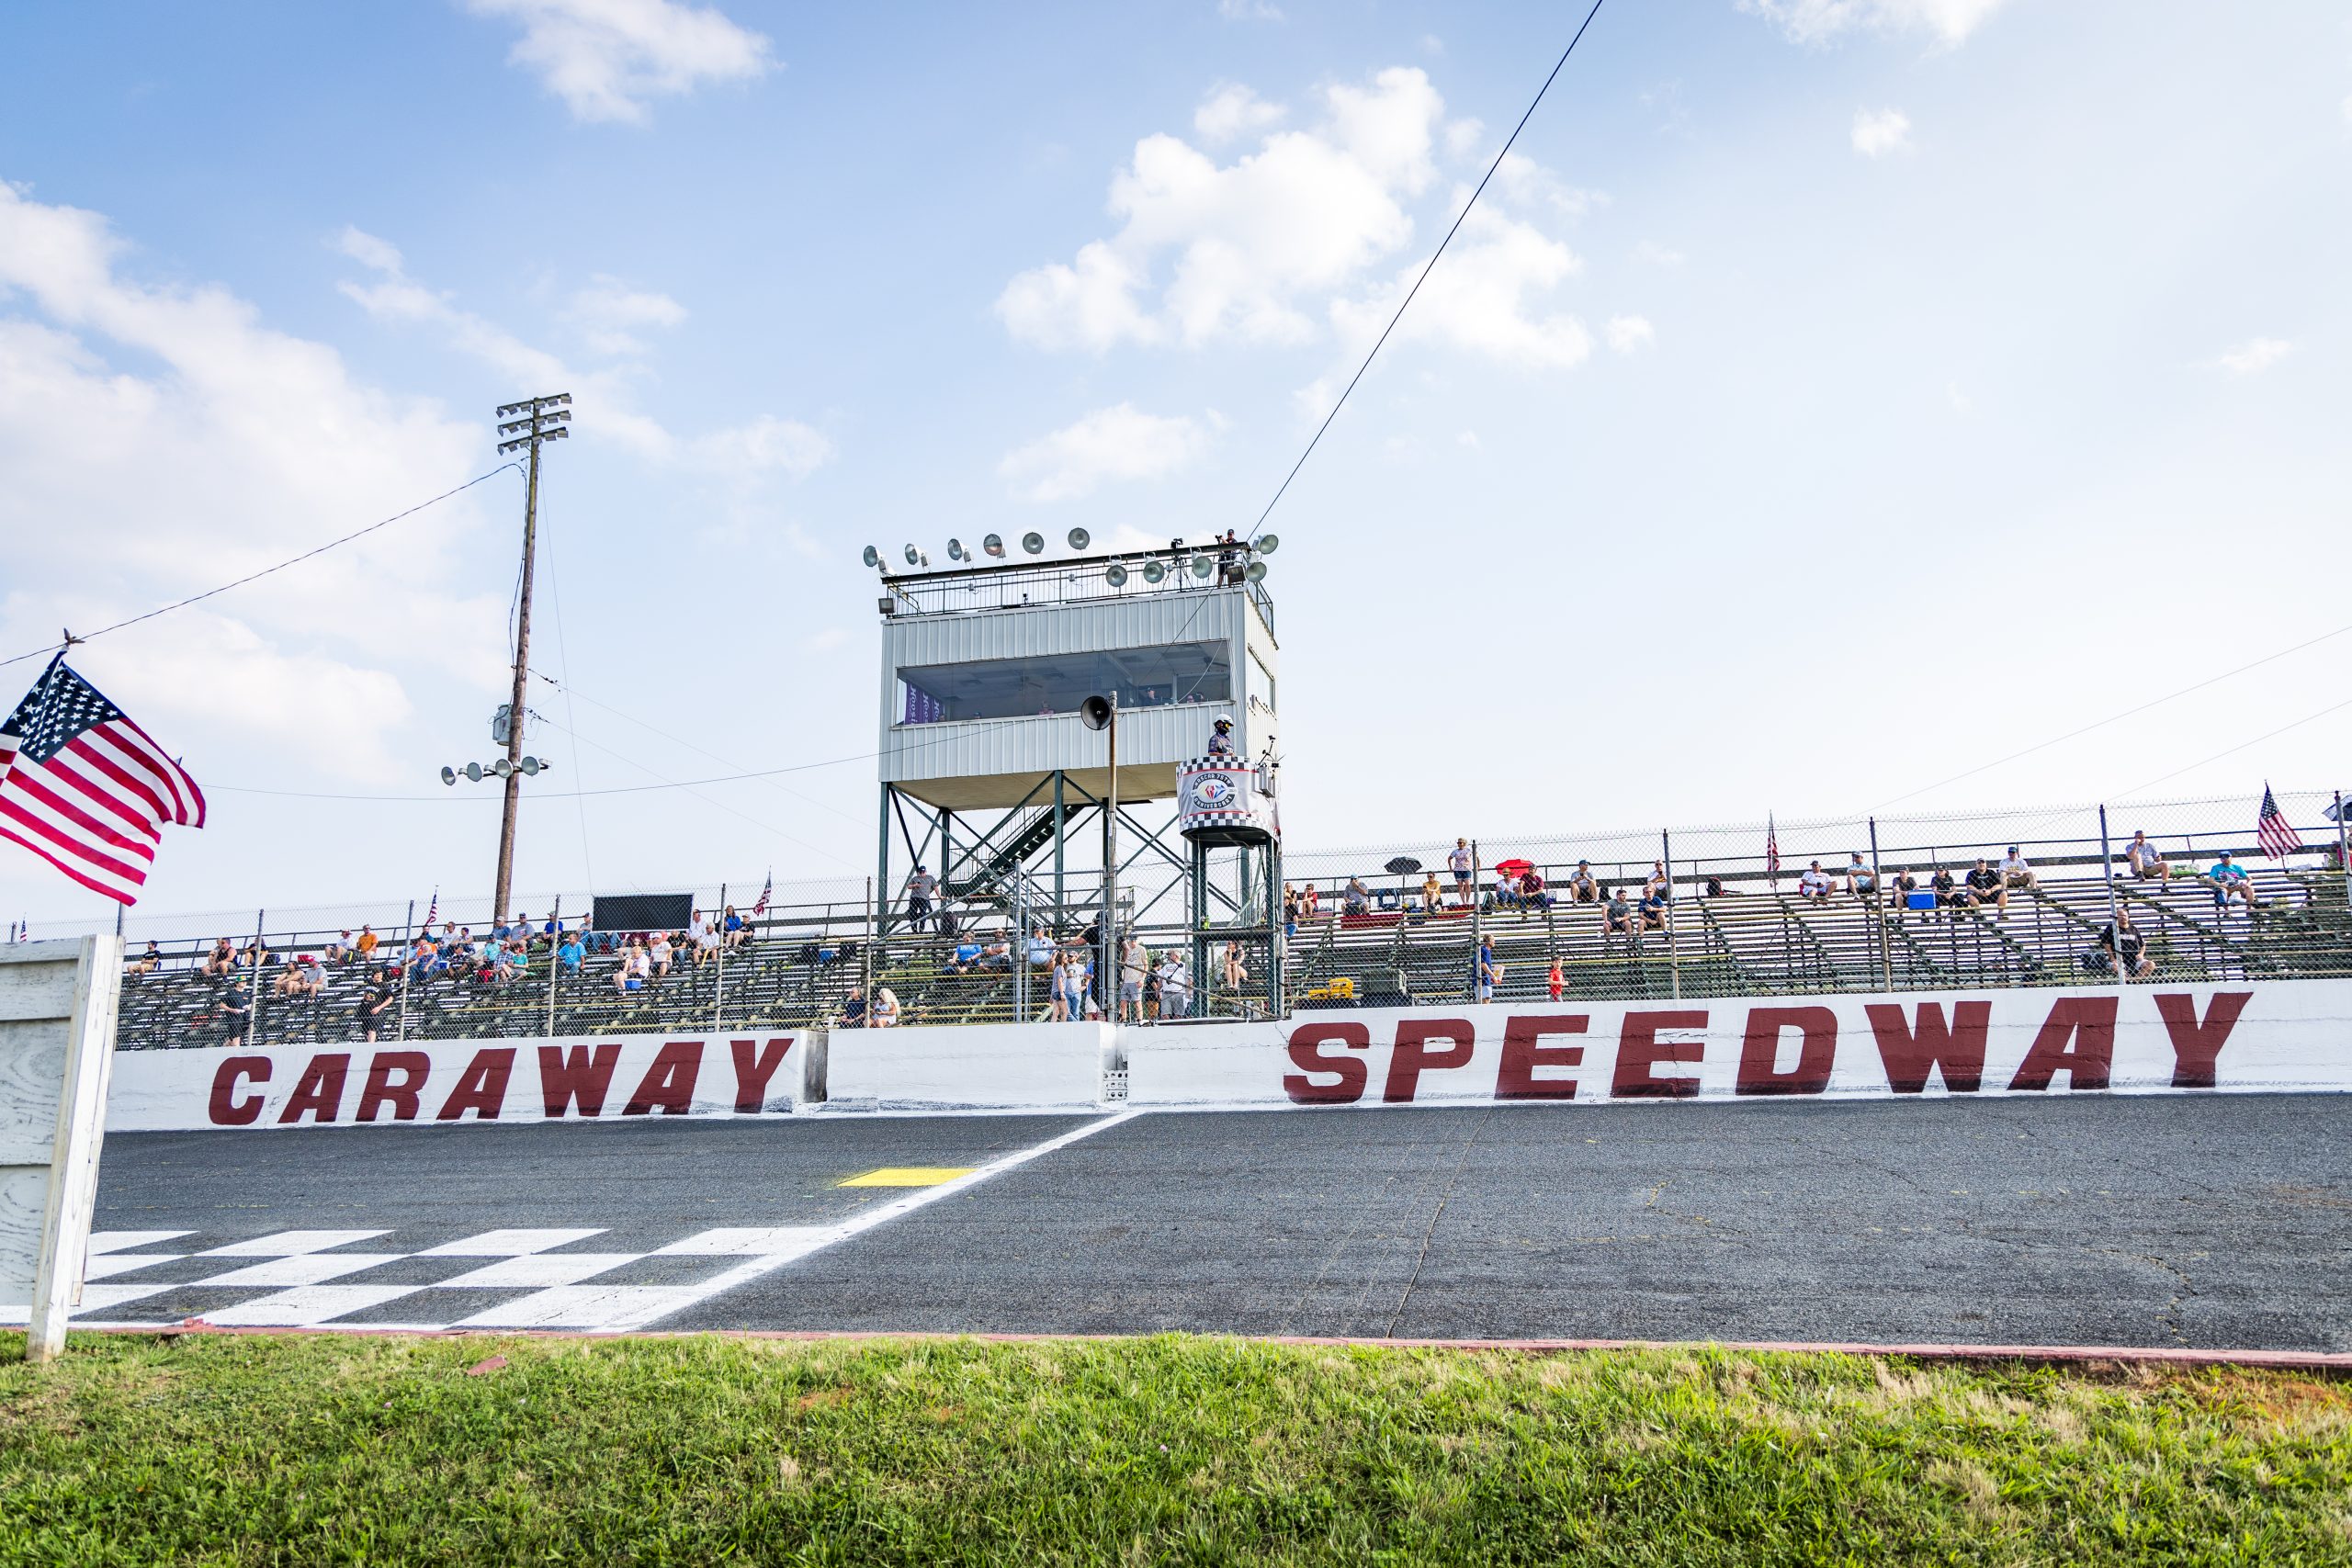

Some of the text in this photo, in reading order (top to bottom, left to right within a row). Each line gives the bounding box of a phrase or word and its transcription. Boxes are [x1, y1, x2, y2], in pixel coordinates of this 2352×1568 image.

[1193, 795, 1233, 808] ANNIVERSARY
[1194, 773, 1231, 786] NASCAR 75TH
[1283, 991, 2254, 1105] SPEEDWAY
[209, 1037, 795, 1126] CARAWAY
